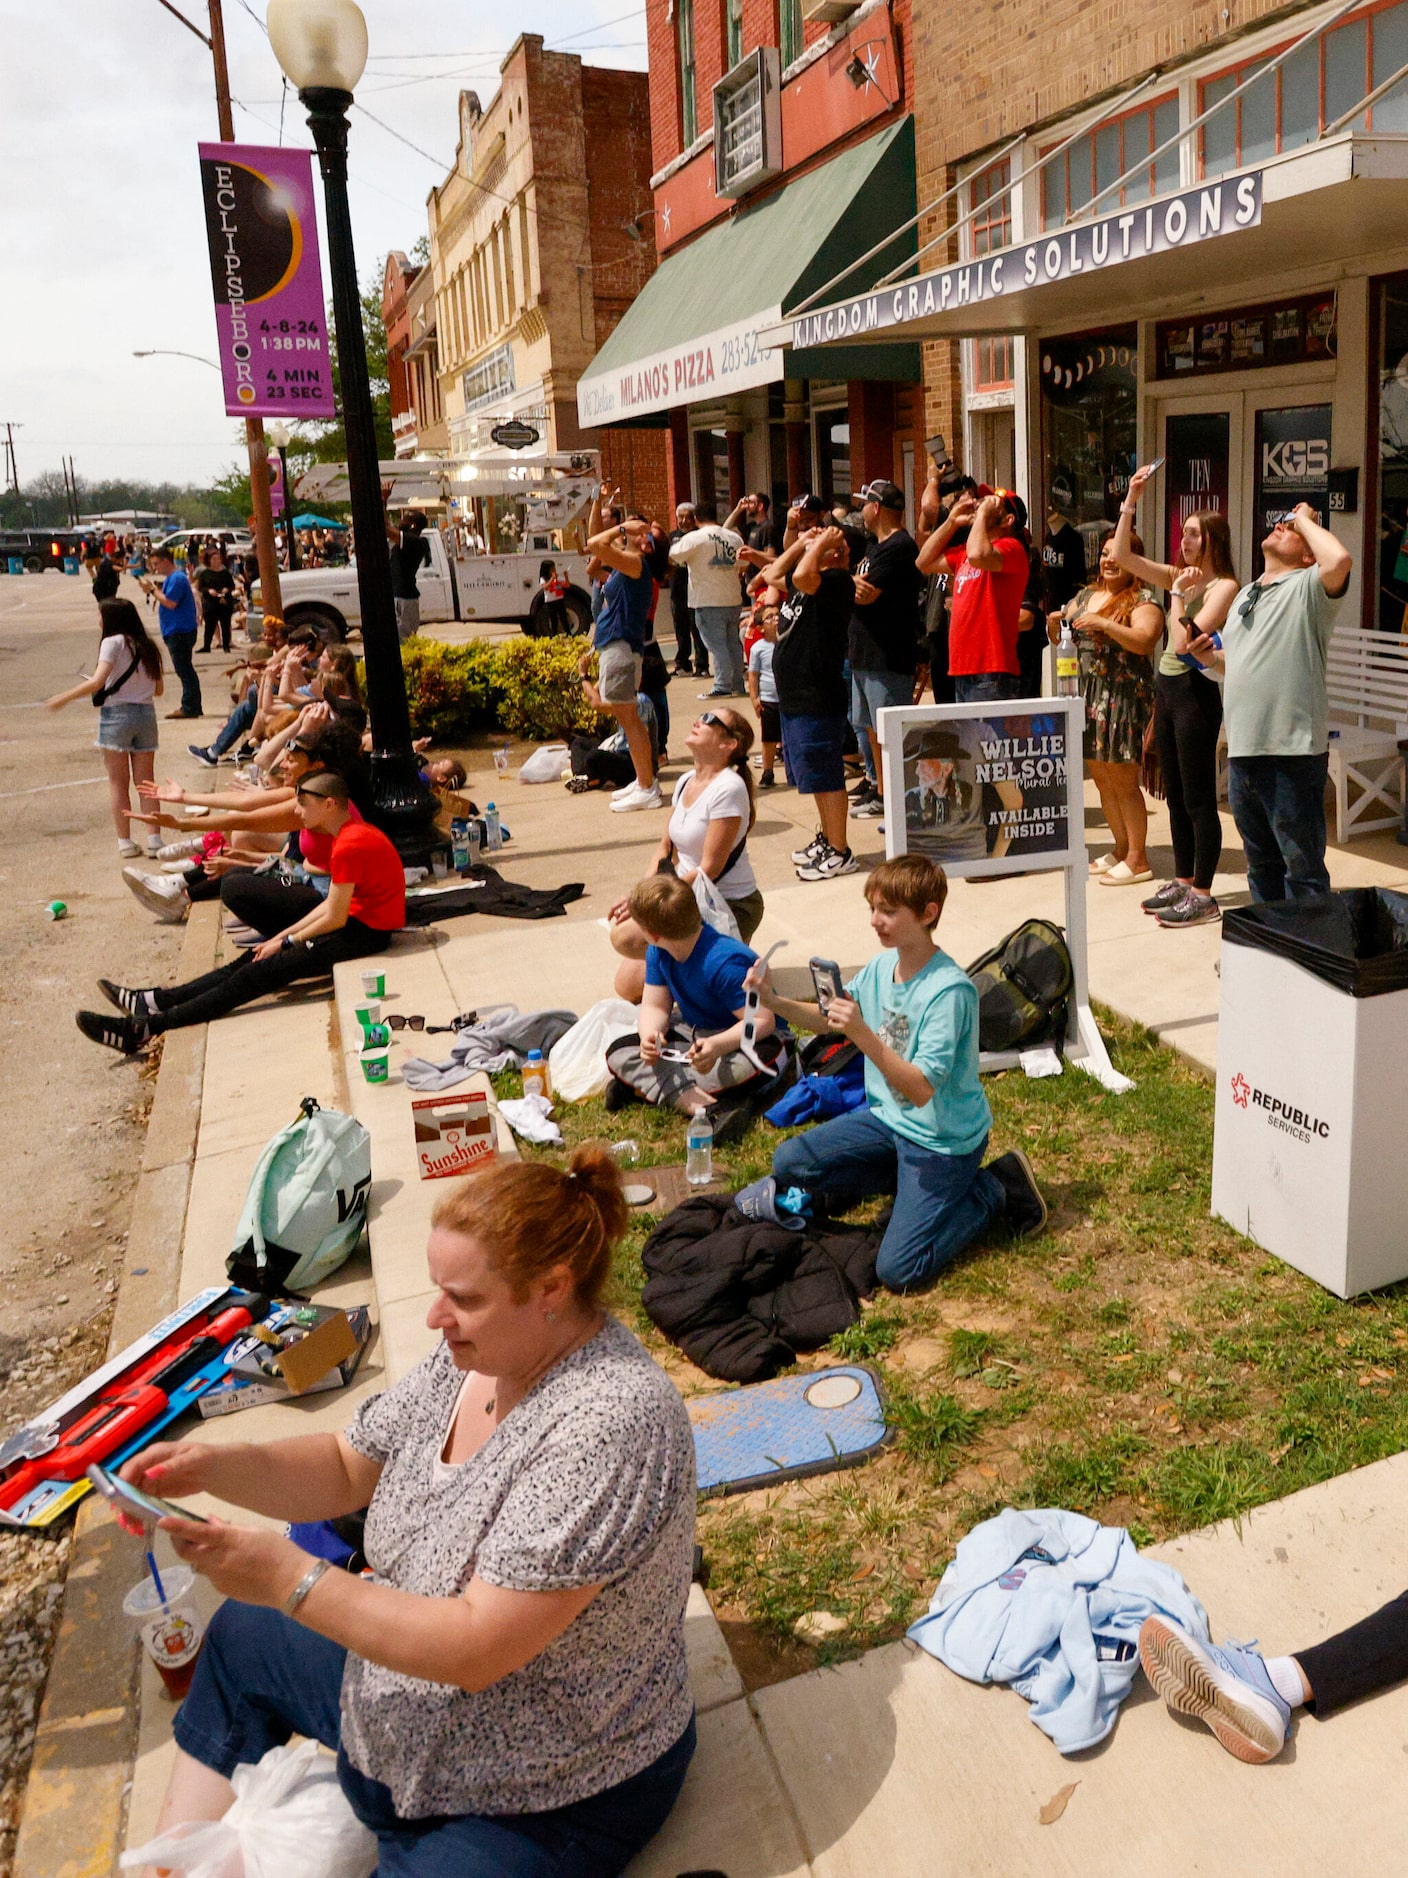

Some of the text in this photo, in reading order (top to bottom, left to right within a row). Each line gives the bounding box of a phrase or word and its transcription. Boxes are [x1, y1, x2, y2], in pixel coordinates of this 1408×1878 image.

[793, 175, 1258, 349] KINGDOM GRAPHIC SOLUTIONS
[215, 166, 256, 404] ECLIPSEBORO
[260, 319, 318, 334] 4-8-24
[261, 337, 321, 352] 1:38 PM
[267, 369, 277, 382] 4
[620, 362, 669, 409] MILANO'S
[674, 347, 715, 392] PIZZA
[267, 386, 286, 399] 23
[1263, 439, 1329, 476] KGS
[1188, 459, 1211, 492] TEN
[1329, 493, 1344, 508] 55
[980, 735, 1064, 761] WILLIE
[975, 756, 1067, 784] NELSON
[1015, 776, 1051, 791] Mural
[988, 805, 1068, 825] AVAILABLE
[1004, 822, 1055, 839] INSIDE
[1252, 1089, 1330, 1138] REPUBLIC
[1267, 1114, 1311, 1144] SERVICES
[421, 1139, 489, 1173] Sunshine
